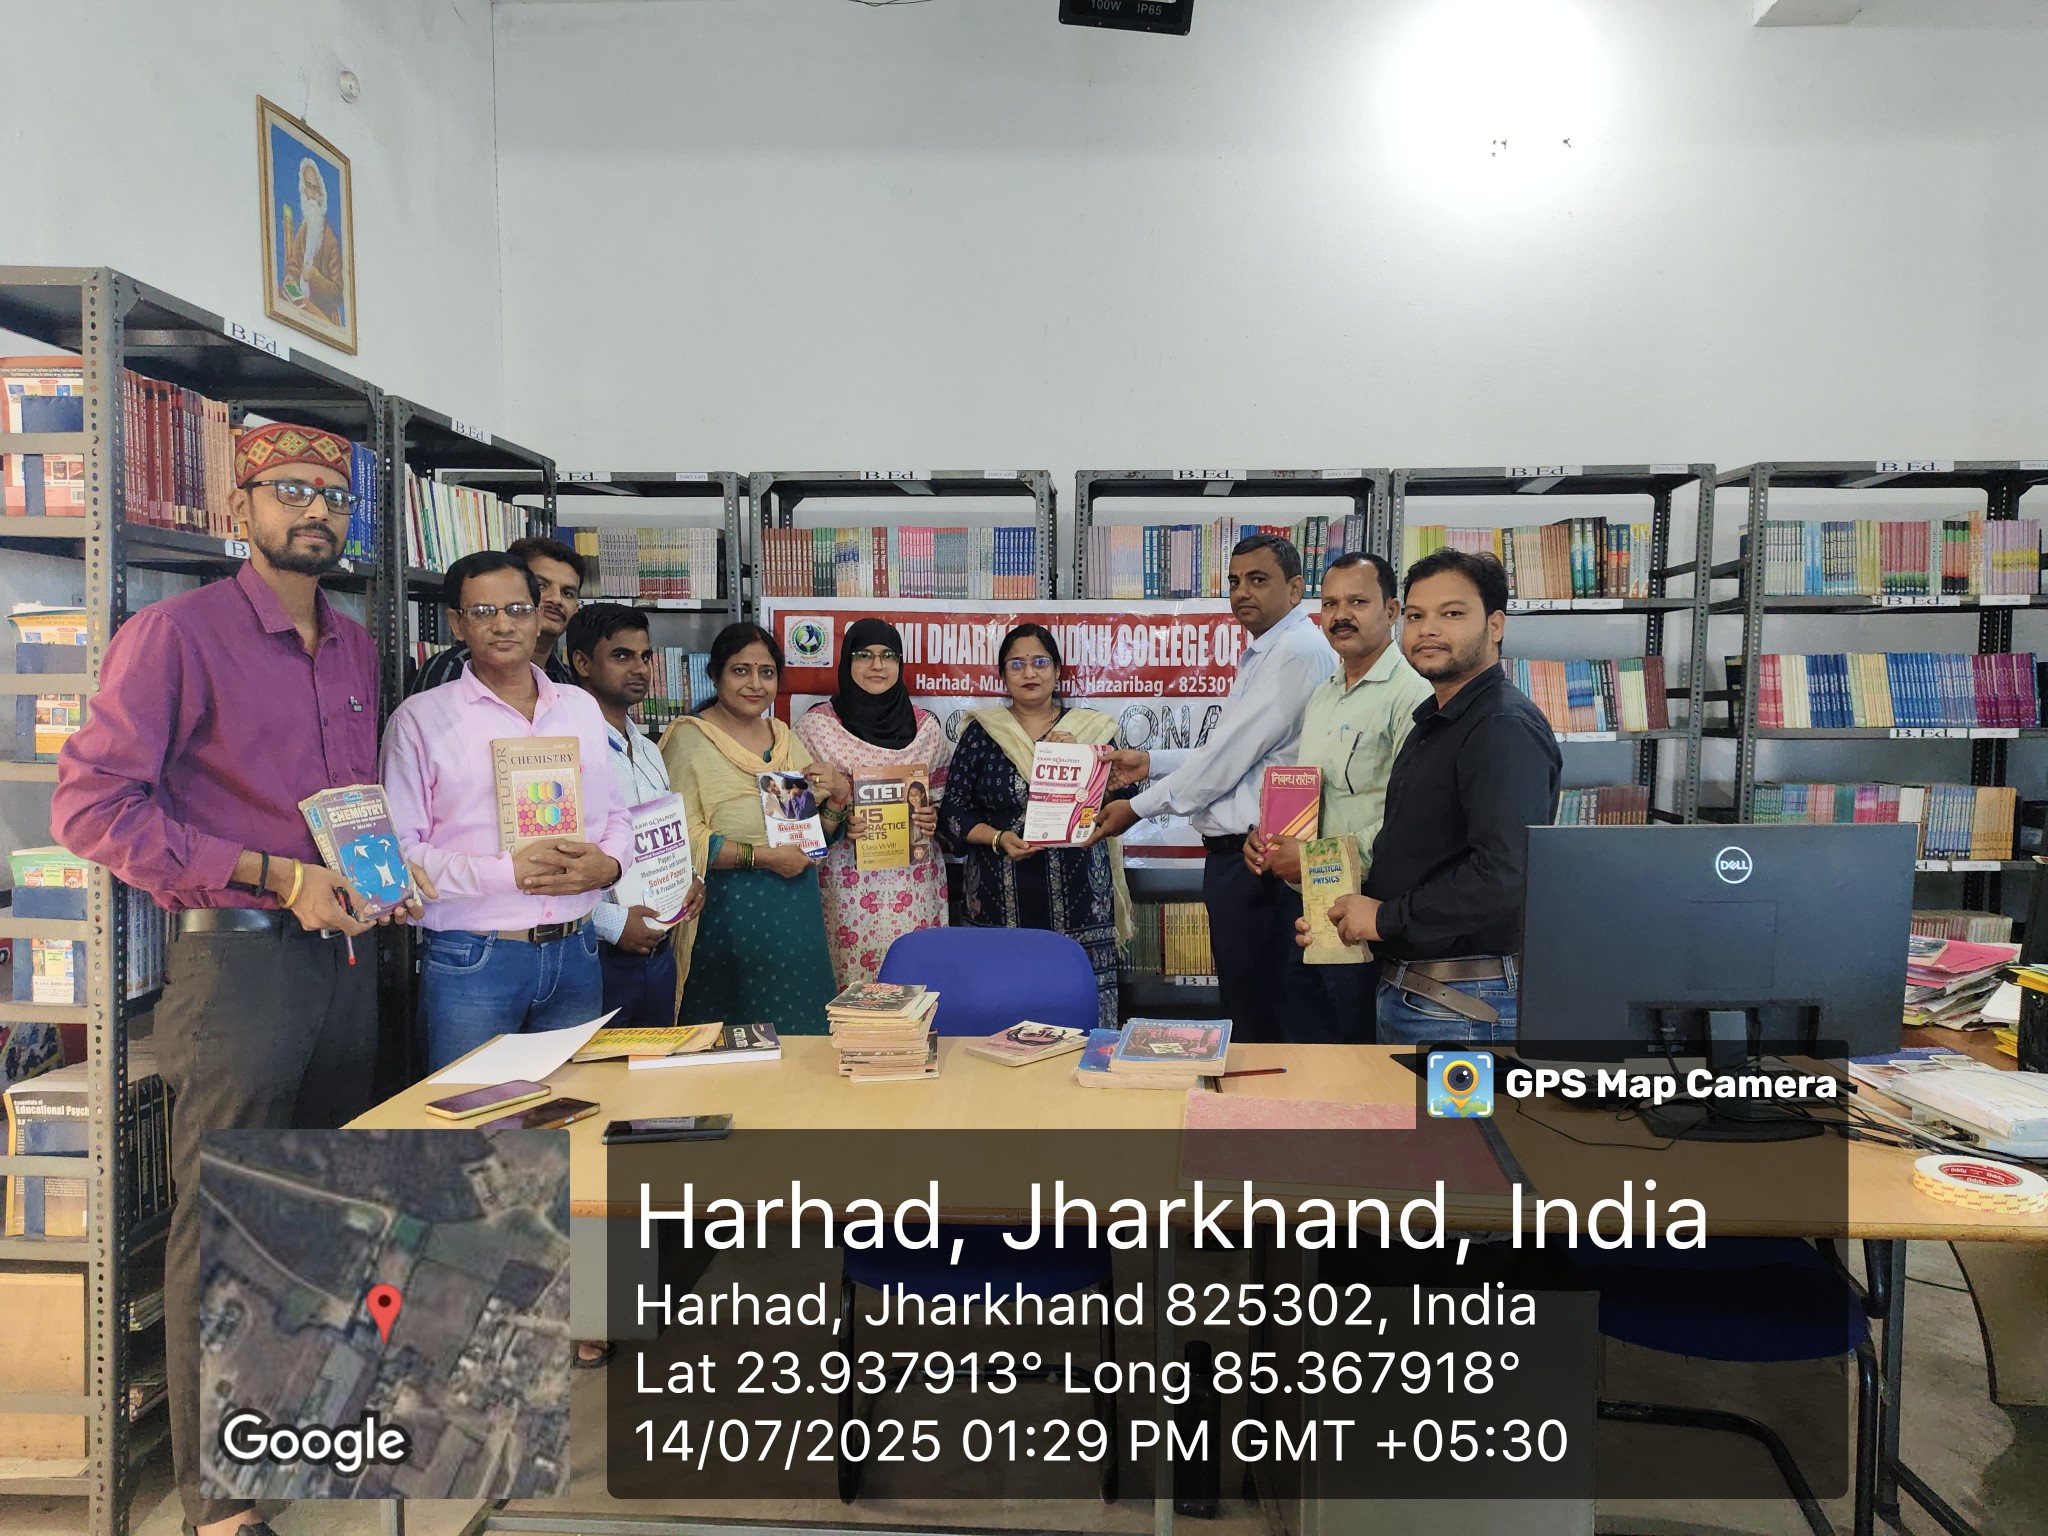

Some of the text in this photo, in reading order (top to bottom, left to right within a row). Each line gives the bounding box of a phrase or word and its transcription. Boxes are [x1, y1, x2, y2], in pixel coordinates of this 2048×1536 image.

[1137, 3, 1162, 16] IP65
[231, 321, 281, 357] B.Ed.
[455, 420, 487, 443] B.Ed.
[1511, 465, 1569, 476] B.Ed.
[1882, 461, 1940, 472] B.Ed.
[865, 471, 919, 480] B.Ed.
[1179, 469, 1234, 479] B.Ed.
[1117, 623, 1210, 667] COLLEGE
[1215, 624, 1242, 667] OF
[916, 673, 975, 693] Harhad,
[1084, 676, 1164, 697] Hazaribag
[1896, 728, 1953, 738] B.Ed.
[510, 753, 574, 766] CHEMISTRY
[1035, 764, 1082, 781] CTET
[858, 782, 906, 800] CTET
[496, 747, 517, 854] SELF-TUTOR
[328, 802, 384, 824] CHEMISTRY
[859, 807, 884, 824] 15
[777, 823, 812, 833] Guidance
[866, 821, 907, 832] RACTICE
[634, 819, 682, 854] CTET
[789, 832, 804, 840] and
[861, 843, 879, 851] Class
[1308, 864, 1343, 875] PRACTICAL
[1720, 860, 1749, 870] DELL
[648, 867, 686, 889] Solved Papers
[1312, 875, 1340, 885] PHYSICS
[15, 1105, 65, 1116] Educational
